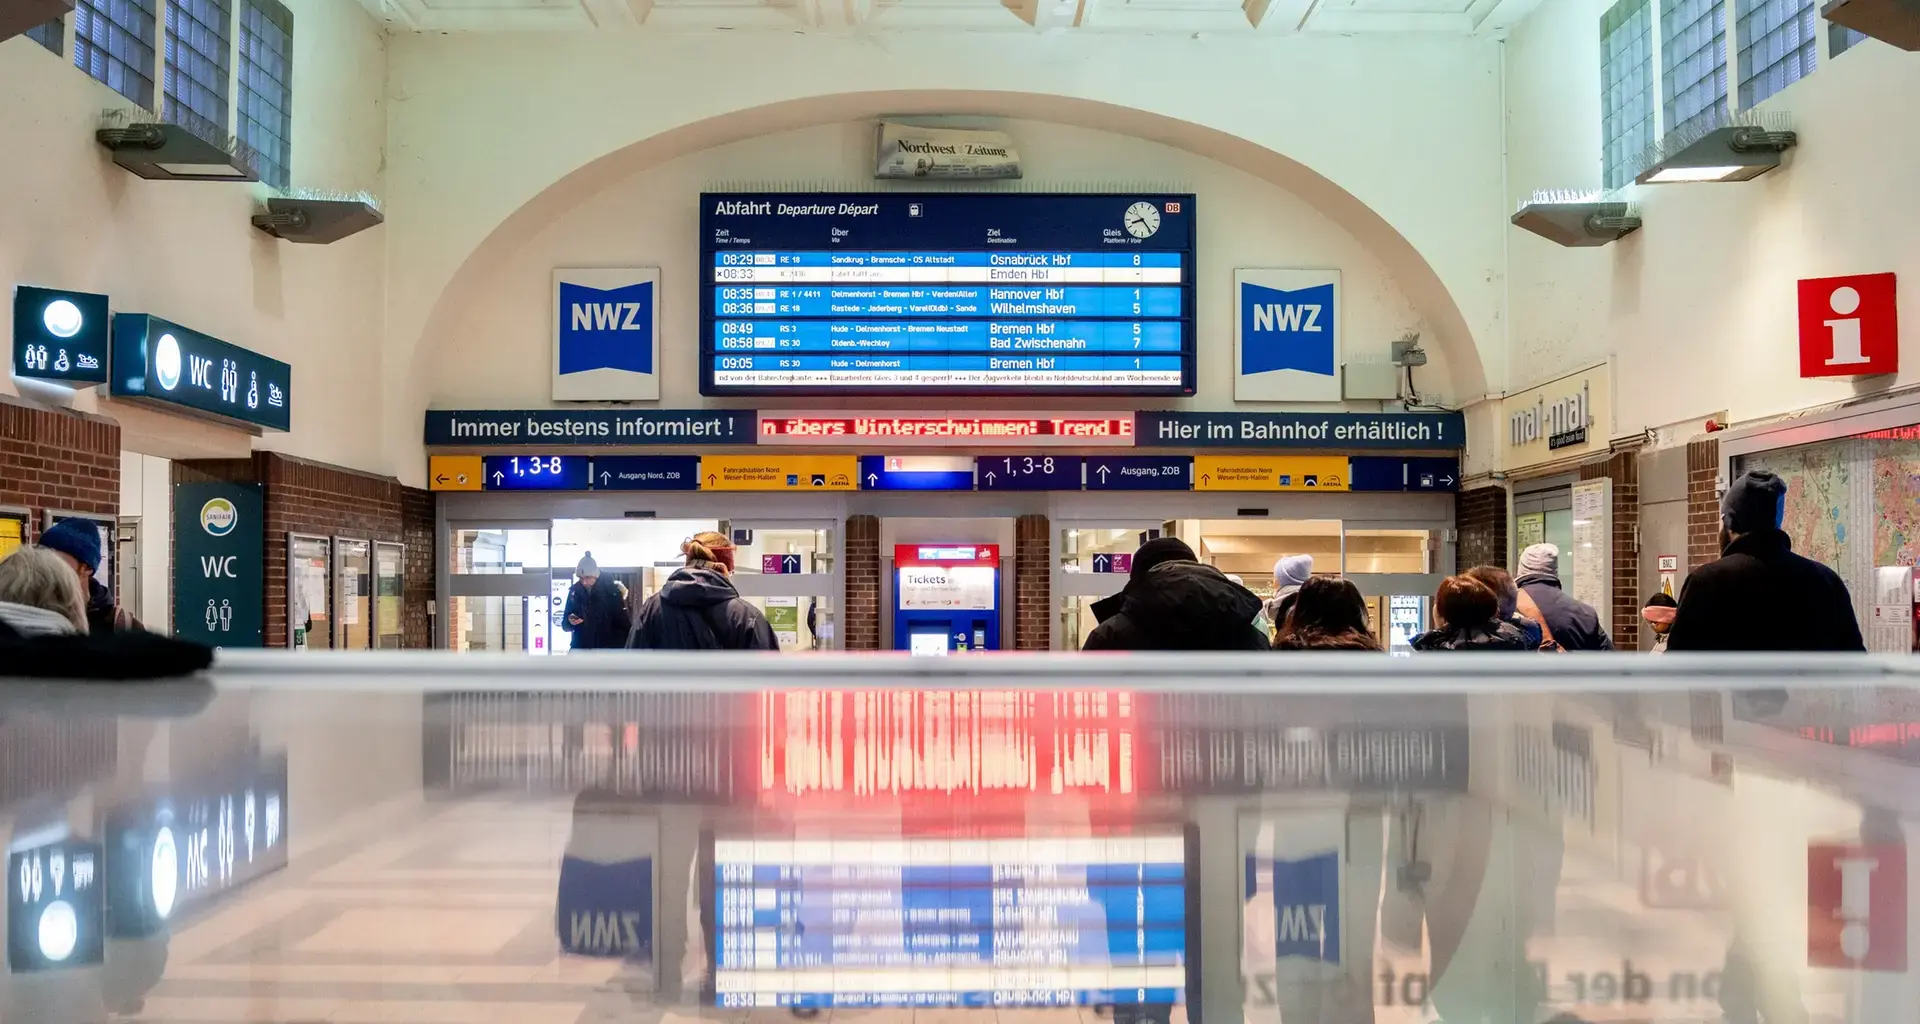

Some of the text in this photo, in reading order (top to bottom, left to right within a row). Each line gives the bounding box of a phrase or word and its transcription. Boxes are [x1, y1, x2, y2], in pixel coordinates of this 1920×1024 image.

[898, 139, 1008, 158] Nordwest Zeitung
[715, 201, 771, 216] Abfahrt
[777, 202, 878, 218] Departure Départ
[1166, 203, 1180, 212] DB
[715, 228, 729, 236] Zeit
[831, 227, 849, 236] Über
[987, 228, 1001, 236] Ziel
[1103, 228, 1121, 236] Gleis
[733, 237, 751, 245] Temps
[723, 254, 753, 265] 08:29
[780, 256, 800, 264] RE 18
[831, 256, 864, 265] Sandkrug
[870, 256, 906, 264] Bramsche
[924, 256, 955, 264] Altstadt
[990, 254, 1072, 266] Osnabrück Hbf
[1133, 255, 1141, 266] 8
[723, 269, 754, 279] 08:33
[990, 269, 1027, 280] Emden
[722, 288, 753, 300] 08:35
[780, 290, 789, 298] RE
[792, 290, 796, 298] 1
[803, 290, 821, 298] 4411
[831, 290, 978, 298] Delmenhorst Bremen Hbf Verden(Aller)
[990, 289, 1064, 300] Hannover Hbf
[1133, 289, 1140, 300] 1
[722, 302, 753, 314] 08:36
[867, 305, 903, 314] Jaderberg
[990, 302, 1076, 314] Wilhelmshaven
[1133, 303, 1141, 314] 5
[572, 302, 641, 331] NWZ
[1253, 303, 1322, 332] NWZ
[722, 323, 753, 334] 08:49
[780, 325, 797, 333] RS 3
[831, 325, 969, 333] Hude Delmenhorst Bremen Neustadt
[990, 323, 1055, 334] Bremen Hbf
[1133, 323, 1141, 334] 5
[722, 337, 753, 348] 08:58
[831, 340, 891, 348] Oldenb.-Wechloy
[990, 337, 1086, 349] Bad Zwischenahn
[1133, 337, 1141, 349] 7
[722, 358, 753, 369] 09:05
[990, 357, 1055, 369] Bremen Hbf
[1133, 358, 1140, 369] 1
[190, 354, 213, 390] WC
[450, 417, 734, 437] Immer bestens informiert !
[762, 419, 1132, 436] n übers Winterschwimmen: Trend E
[1159, 420, 1443, 441] Hier im Bahnhof erhältlich !
[510, 456, 562, 477] 1, 3-8
[1002, 457, 1055, 477] 1, 3-8
[1121, 466, 1180, 477] Ausgang, ZOB
[618, 472, 681, 481] Ausgang Nord, ZOB
[206, 513, 232, 521] SANIFAIR
[201, 555, 237, 578] WC
[1662, 559, 1673, 568] BMZ
[907, 575, 946, 584] Tickets
